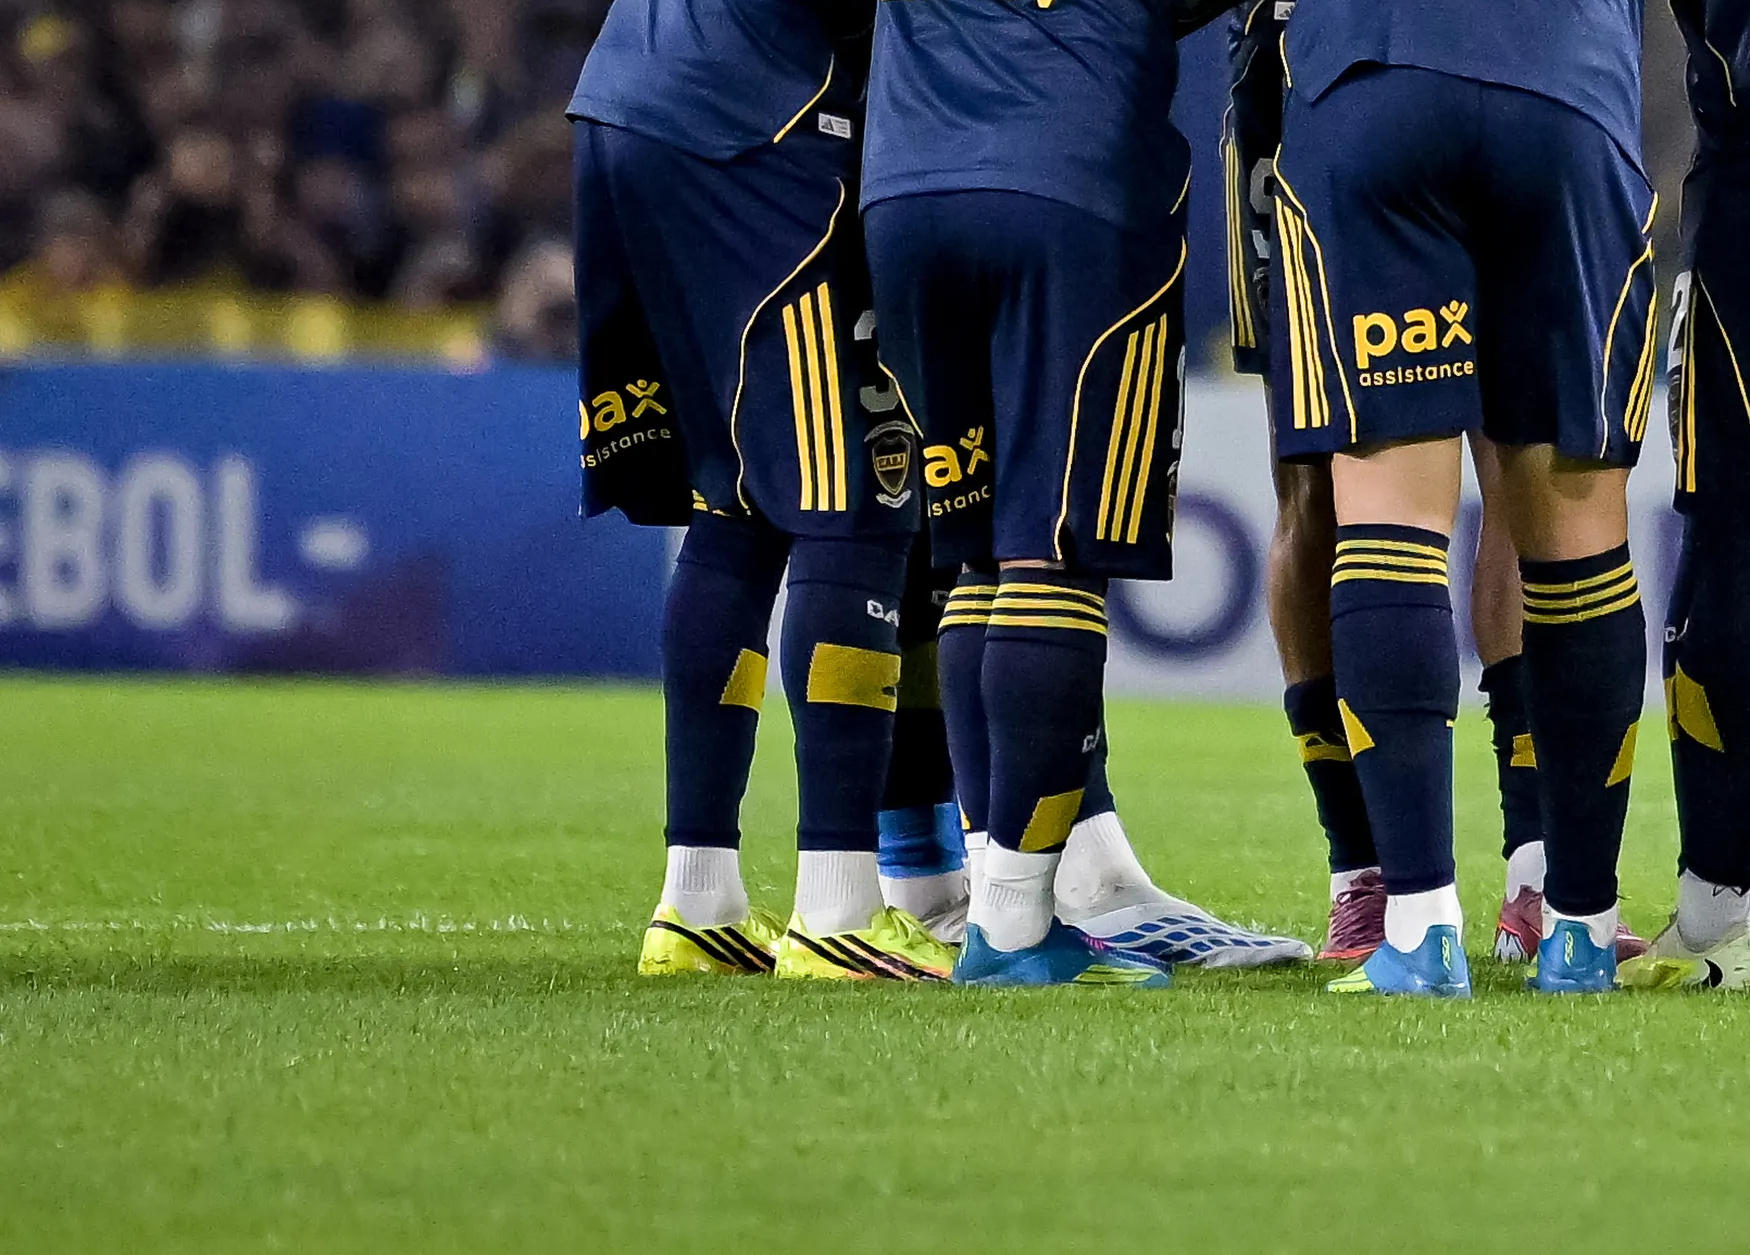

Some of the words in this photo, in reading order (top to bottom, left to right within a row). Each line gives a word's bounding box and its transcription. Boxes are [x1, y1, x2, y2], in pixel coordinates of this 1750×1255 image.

[1352, 300, 1473, 369] pax
[1359, 360, 1474, 387] assistance
[0, 450, 296, 634] BOL
